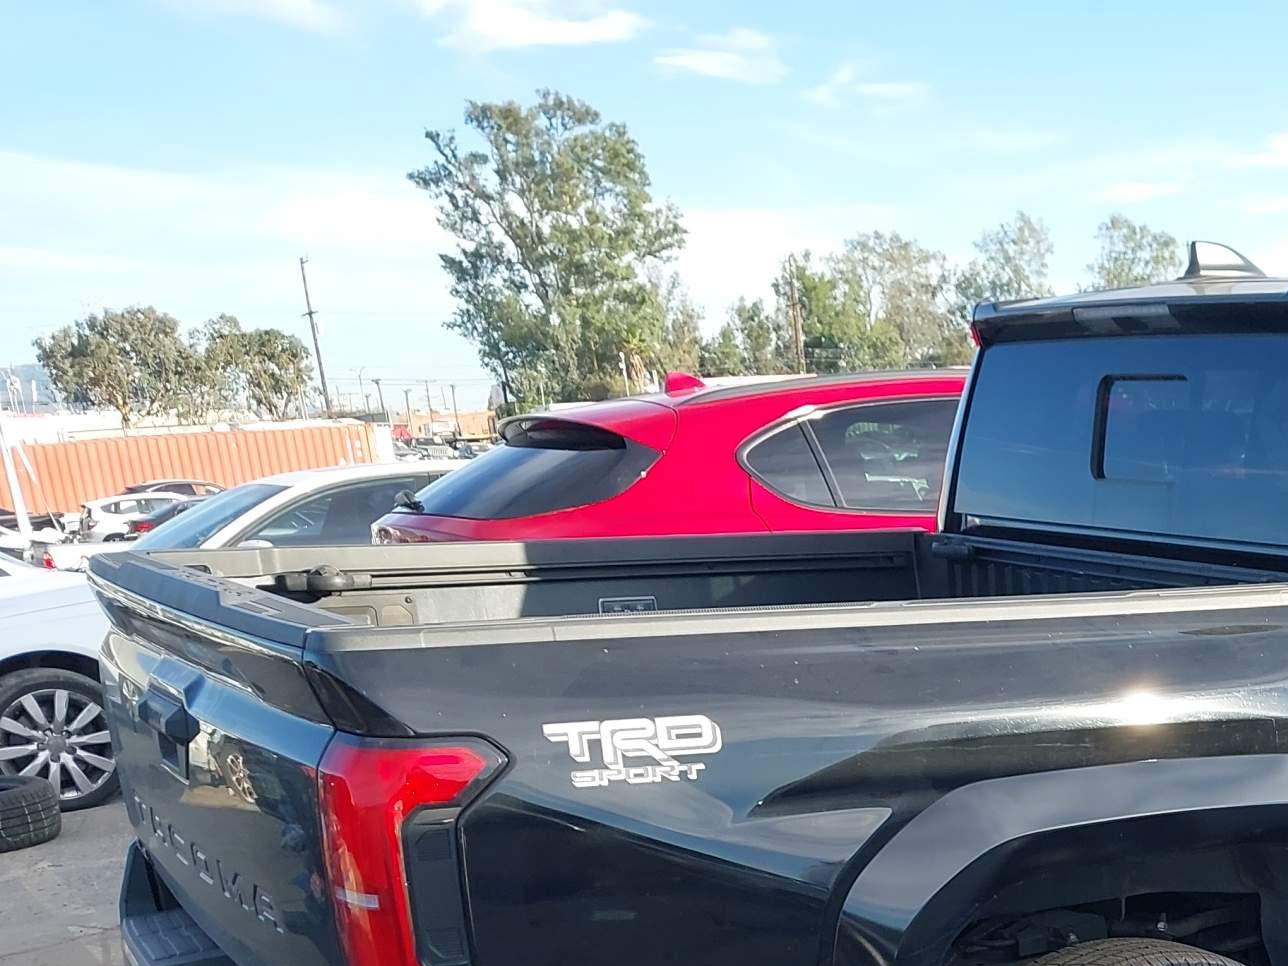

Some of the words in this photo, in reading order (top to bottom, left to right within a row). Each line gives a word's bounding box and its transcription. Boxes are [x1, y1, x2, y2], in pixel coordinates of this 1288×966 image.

[542, 714, 723, 769] TRD
[571, 761, 706, 788] SPORT
[133, 793, 284, 934] TACOMA
